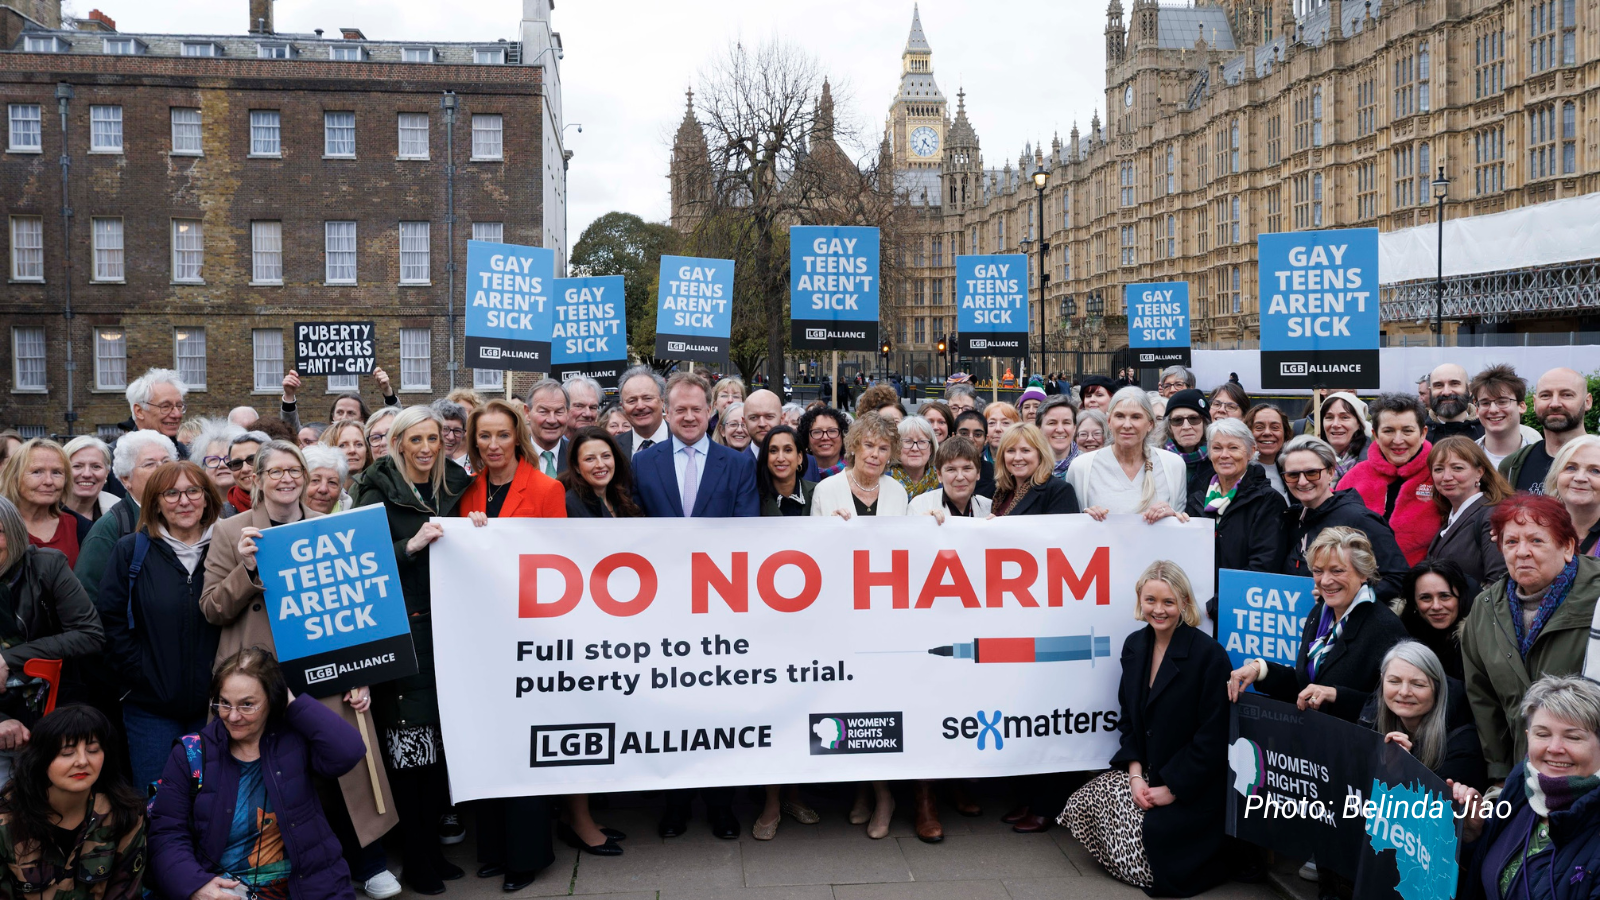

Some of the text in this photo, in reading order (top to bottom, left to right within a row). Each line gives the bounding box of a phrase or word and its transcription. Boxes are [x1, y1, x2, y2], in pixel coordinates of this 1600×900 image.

[813, 237, 857, 254] GAY
[490, 254, 534, 274] GAY
[802, 256, 867, 273] TEENS
[1288, 244, 1348, 267] GAY
[678, 265, 716, 282] GAY
[974, 264, 1010, 278] GAY
[1275, 268, 1362, 291] TEENS
[479, 272, 542, 294] TEENS
[669, 280, 723, 298] TEENS
[797, 275, 873, 292] AREN'T
[966, 279, 1018, 294] TEENS
[472, 290, 547, 313] AREN'T
[564, 286, 605, 304] GAY
[811, 293, 859, 311] SICK
[962, 294, 1023, 309] AREN'T
[1142, 289, 1173, 303] GAY
[1268, 291, 1370, 315] AREN'T
[556, 303, 615, 321] TEENS
[663, 296, 727, 314] AREN'T
[1135, 303, 1181, 316] TEENS
[486, 310, 533, 330] SICK
[674, 312, 714, 328] SICK
[974, 310, 1012, 324] SICK
[1132, 315, 1185, 329] AREN'T
[299, 325, 370, 340] PUBERTY
[552, 319, 620, 338] AREN'T
[807, 329, 866, 339] LGB ALLIANCE
[1143, 328, 1176, 341] SICK
[1287, 316, 1351, 338] SICK
[299, 341, 372, 357] BLOCKERS
[565, 337, 609, 354] SICK
[669, 343, 718, 353] LGB ALLIANCE
[971, 340, 985, 348] LGB
[482, 347, 539, 360] LGB ALLIANCE
[582, 370, 616, 378] ALLIANCE
[1282, 363, 1361, 374] LGB ALLIANCE
[291, 529, 355, 562] GAY
[279, 552, 378, 591] TEENS
[518, 547, 1110, 618] DO NO HARM
[279, 575, 389, 620] AREN'T
[1246, 587, 1301, 612] GAY
[305, 604, 377, 640] SICK
[516, 634, 750, 663] Full stop to the
[1225, 632, 1302, 661] AREN
[307, 653, 395, 682] LGB ALLIANCE
[516, 660, 853, 698] puberty blockers trial.
[847, 717, 895, 727] WOMEN'S
[1261, 710, 1304, 725] ALLIANC
[539, 725, 772, 760] LGB ALLIANCE
[848, 729, 882, 738] RIGHTS
[848, 739, 897, 749] NETWORK
[1266, 750, 1329, 782] WOMEN'S
[1267, 770, 1318, 799] RIGHTS
